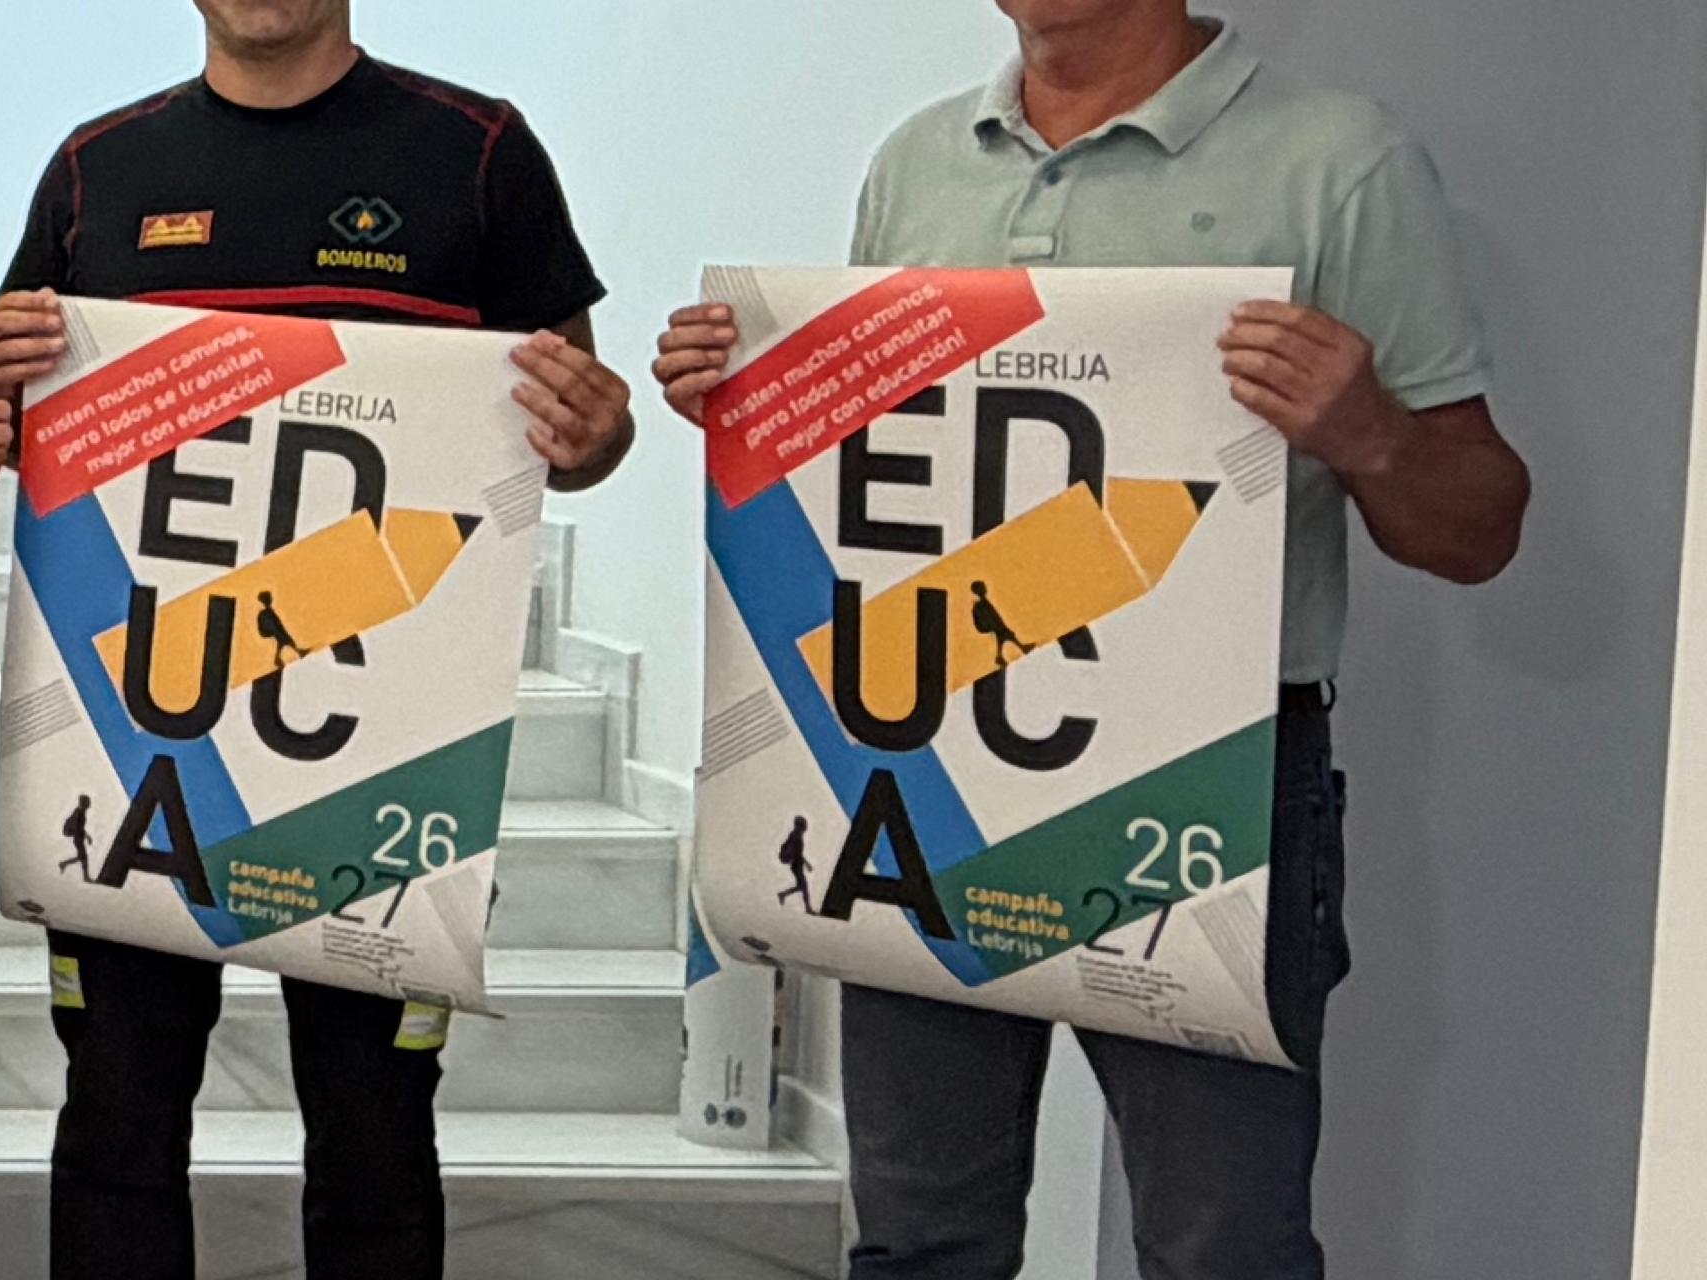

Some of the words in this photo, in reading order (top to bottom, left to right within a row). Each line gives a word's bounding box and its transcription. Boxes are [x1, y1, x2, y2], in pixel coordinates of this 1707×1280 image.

[317, 249, 407, 273] BOMBEROS
[783, 332, 852, 384] muchos
[865, 306, 952, 367] transitan
[97, 366, 167, 409] muchos
[154, 387, 176, 408] se
[179, 347, 264, 398] transitan
[976, 350, 1110, 382] LEBRIJA
[279, 391, 397, 423] LEBRIJA
[776, 419, 827, 458] mejor
[830, 395, 865, 422] con
[140, 421, 174, 448] con
[372, 803, 458, 872] 26
[1125, 817, 1223, 895] 26
[331, 864, 410, 928] 27
[965, 886, 1063, 917] campaña
[966, 908, 1070, 941] educativa
[968, 928, 1043, 959] Lebrija
[1082, 887, 1172, 961] 27
